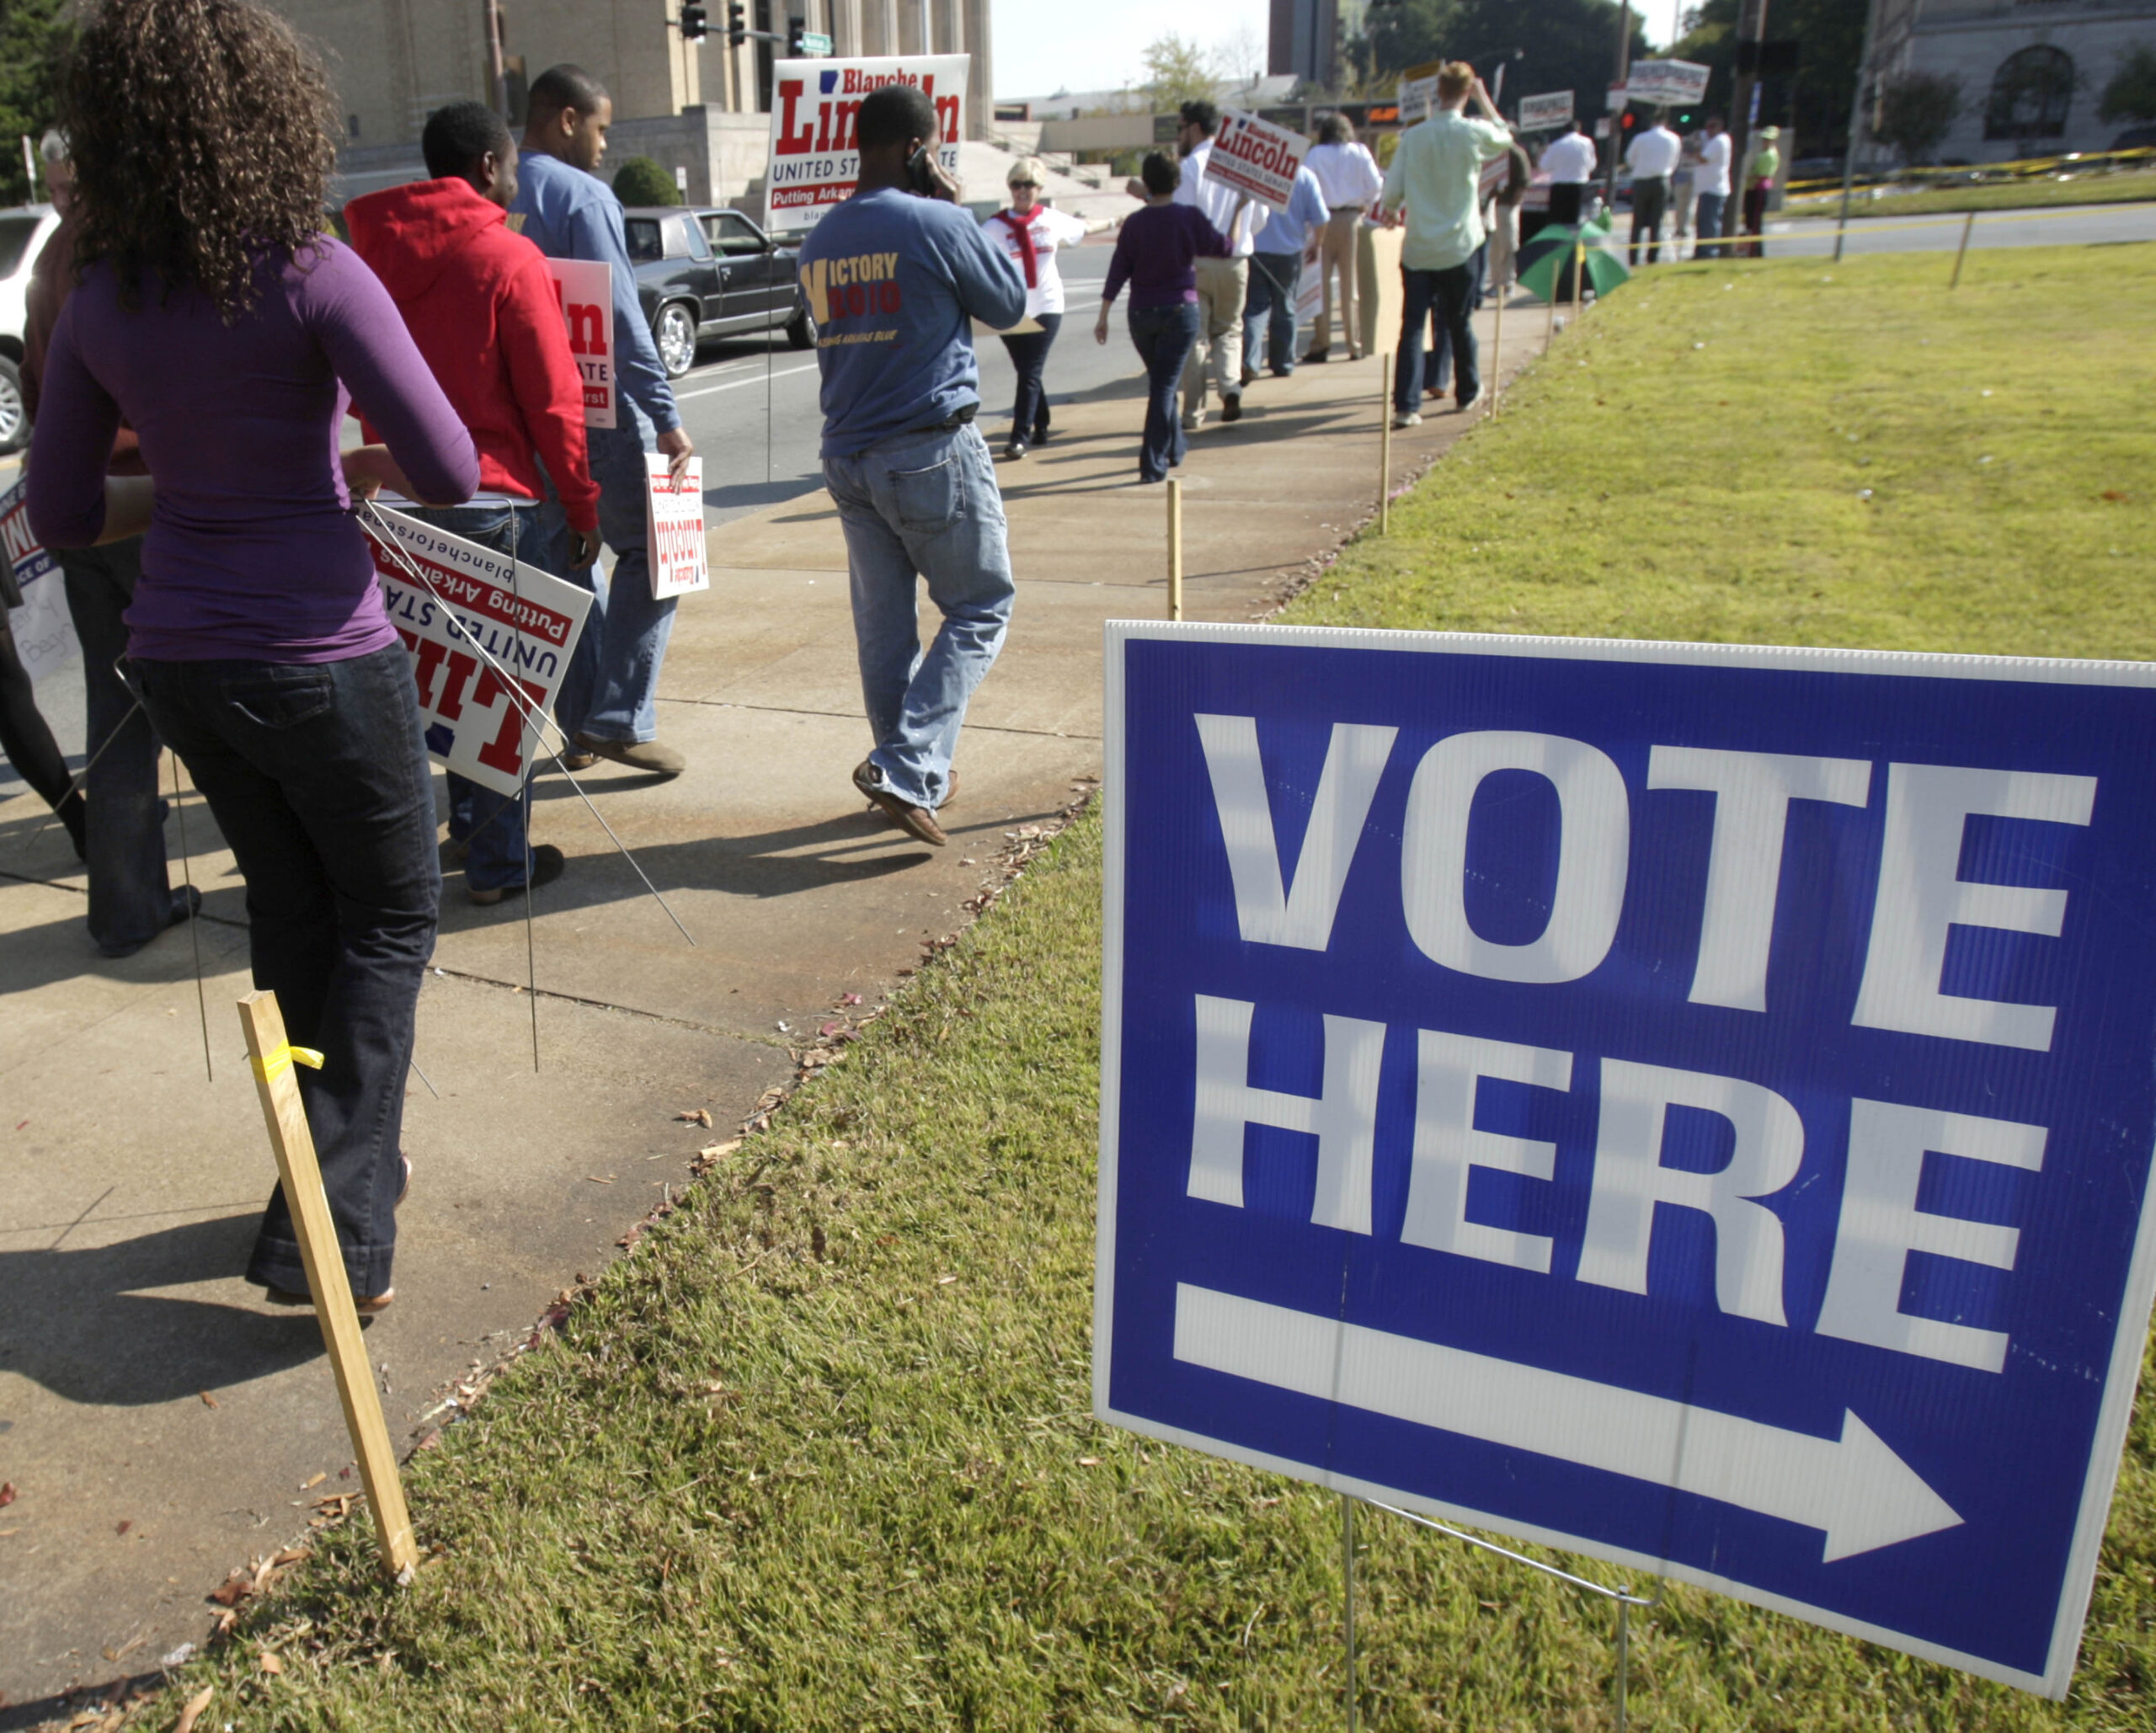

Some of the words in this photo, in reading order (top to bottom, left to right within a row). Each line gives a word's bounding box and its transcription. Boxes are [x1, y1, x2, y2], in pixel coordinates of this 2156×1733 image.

[773, 159, 834, 182] UNITED
[1214, 115, 1299, 180] Lincoln
[773, 189, 814, 206] Putting
[800, 252, 899, 326] VICTORY
[827, 280, 901, 319] 2010
[35, 556, 51, 573] OF
[380, 545, 482, 602] Arkansas
[657, 519, 707, 583] Lincoln
[488, 589, 566, 640] Putting
[446, 616, 558, 678] UNITED
[1193, 712, 2099, 1053] VOTE
[1186, 993, 2050, 1374] HERE
